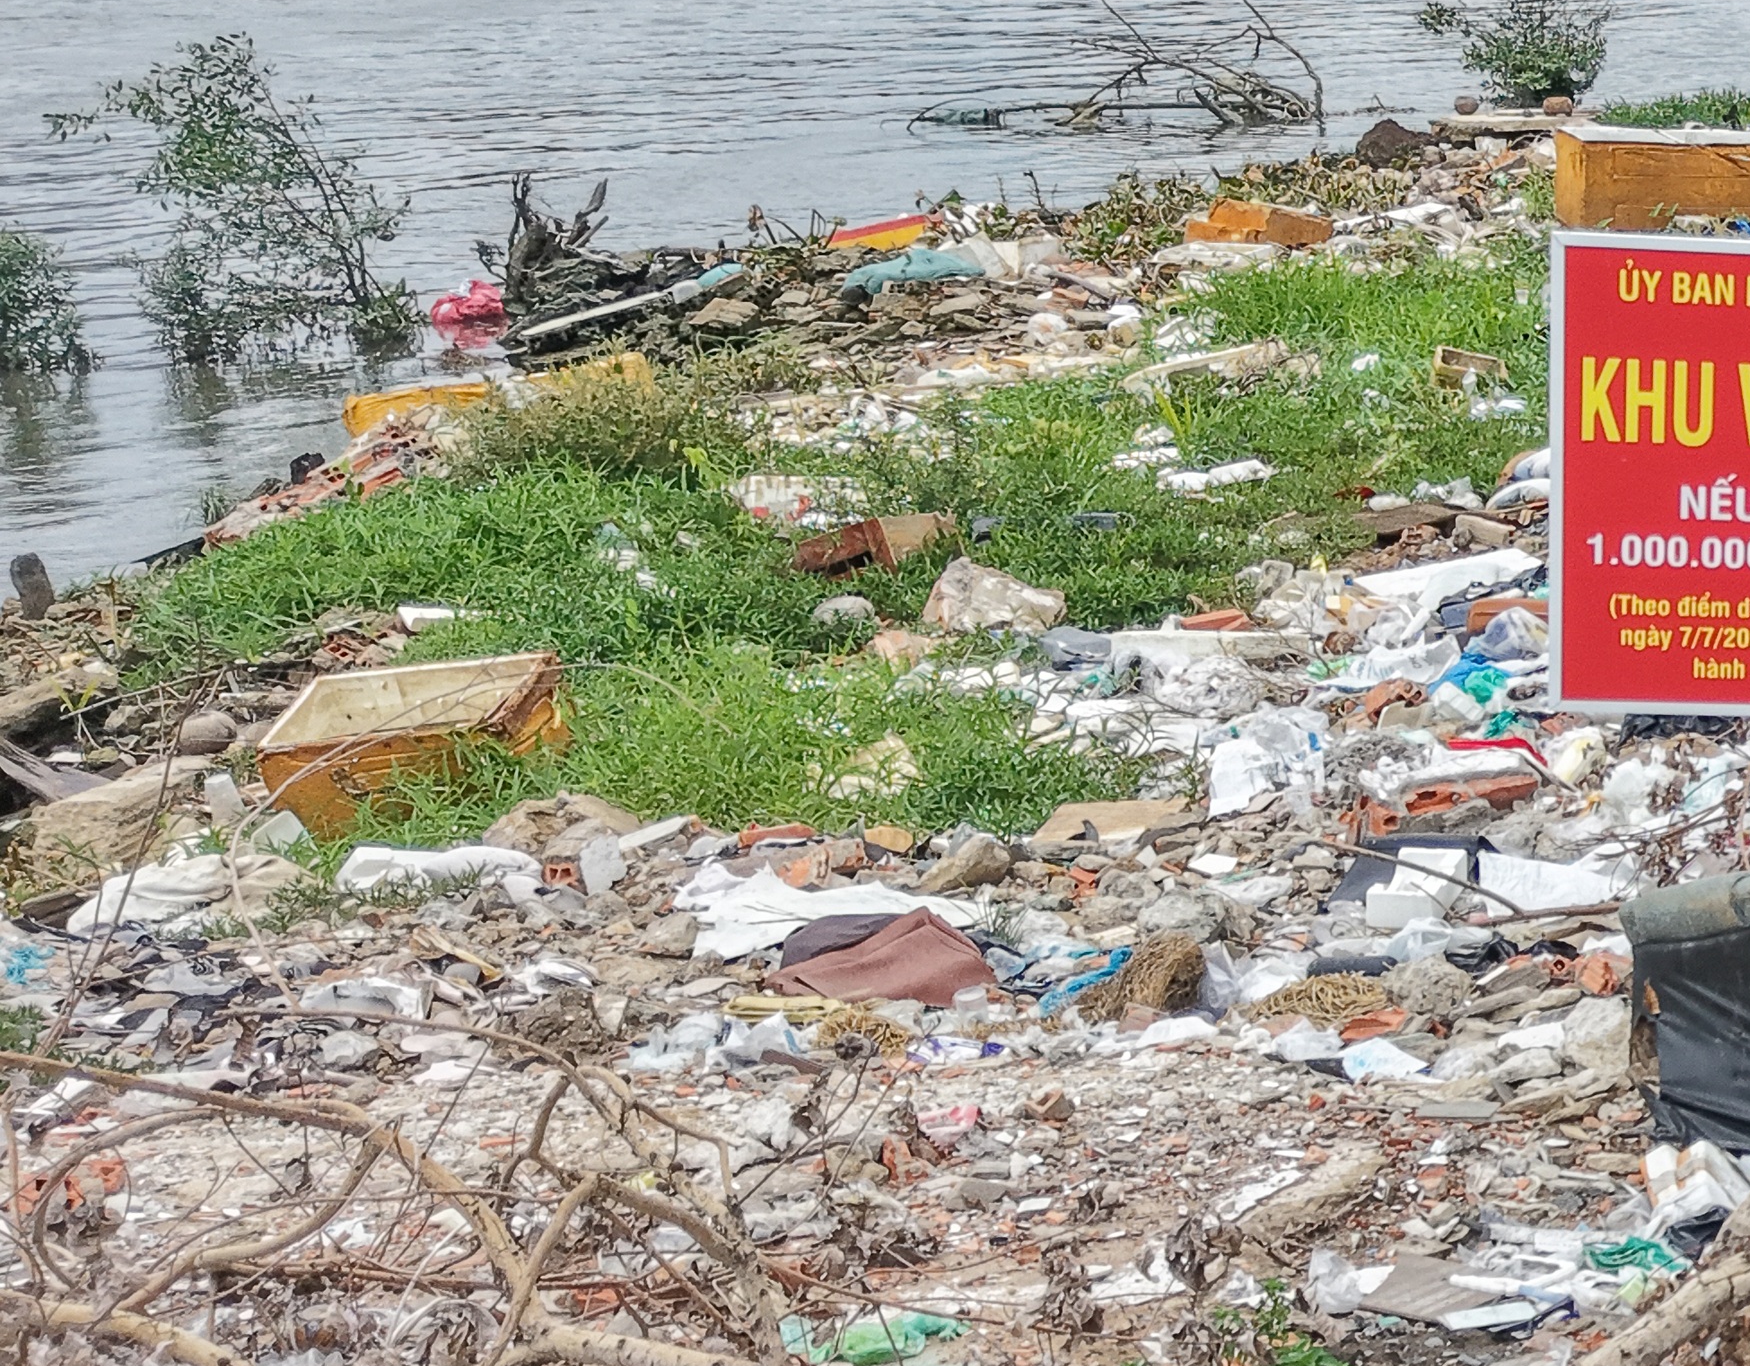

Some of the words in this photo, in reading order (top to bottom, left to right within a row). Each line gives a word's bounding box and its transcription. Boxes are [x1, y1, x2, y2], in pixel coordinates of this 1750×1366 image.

[1618, 258, 1662, 302] ỦY
[1672, 270, 1735, 307] BAN
[1580, 356, 1715, 447] KHU
[1609, 593, 1671, 620] (Theo
[1677, 591, 1731, 619] điểm
[1619, 625, 1673, 652] ngày
[1693, 656, 1746, 681] hành
